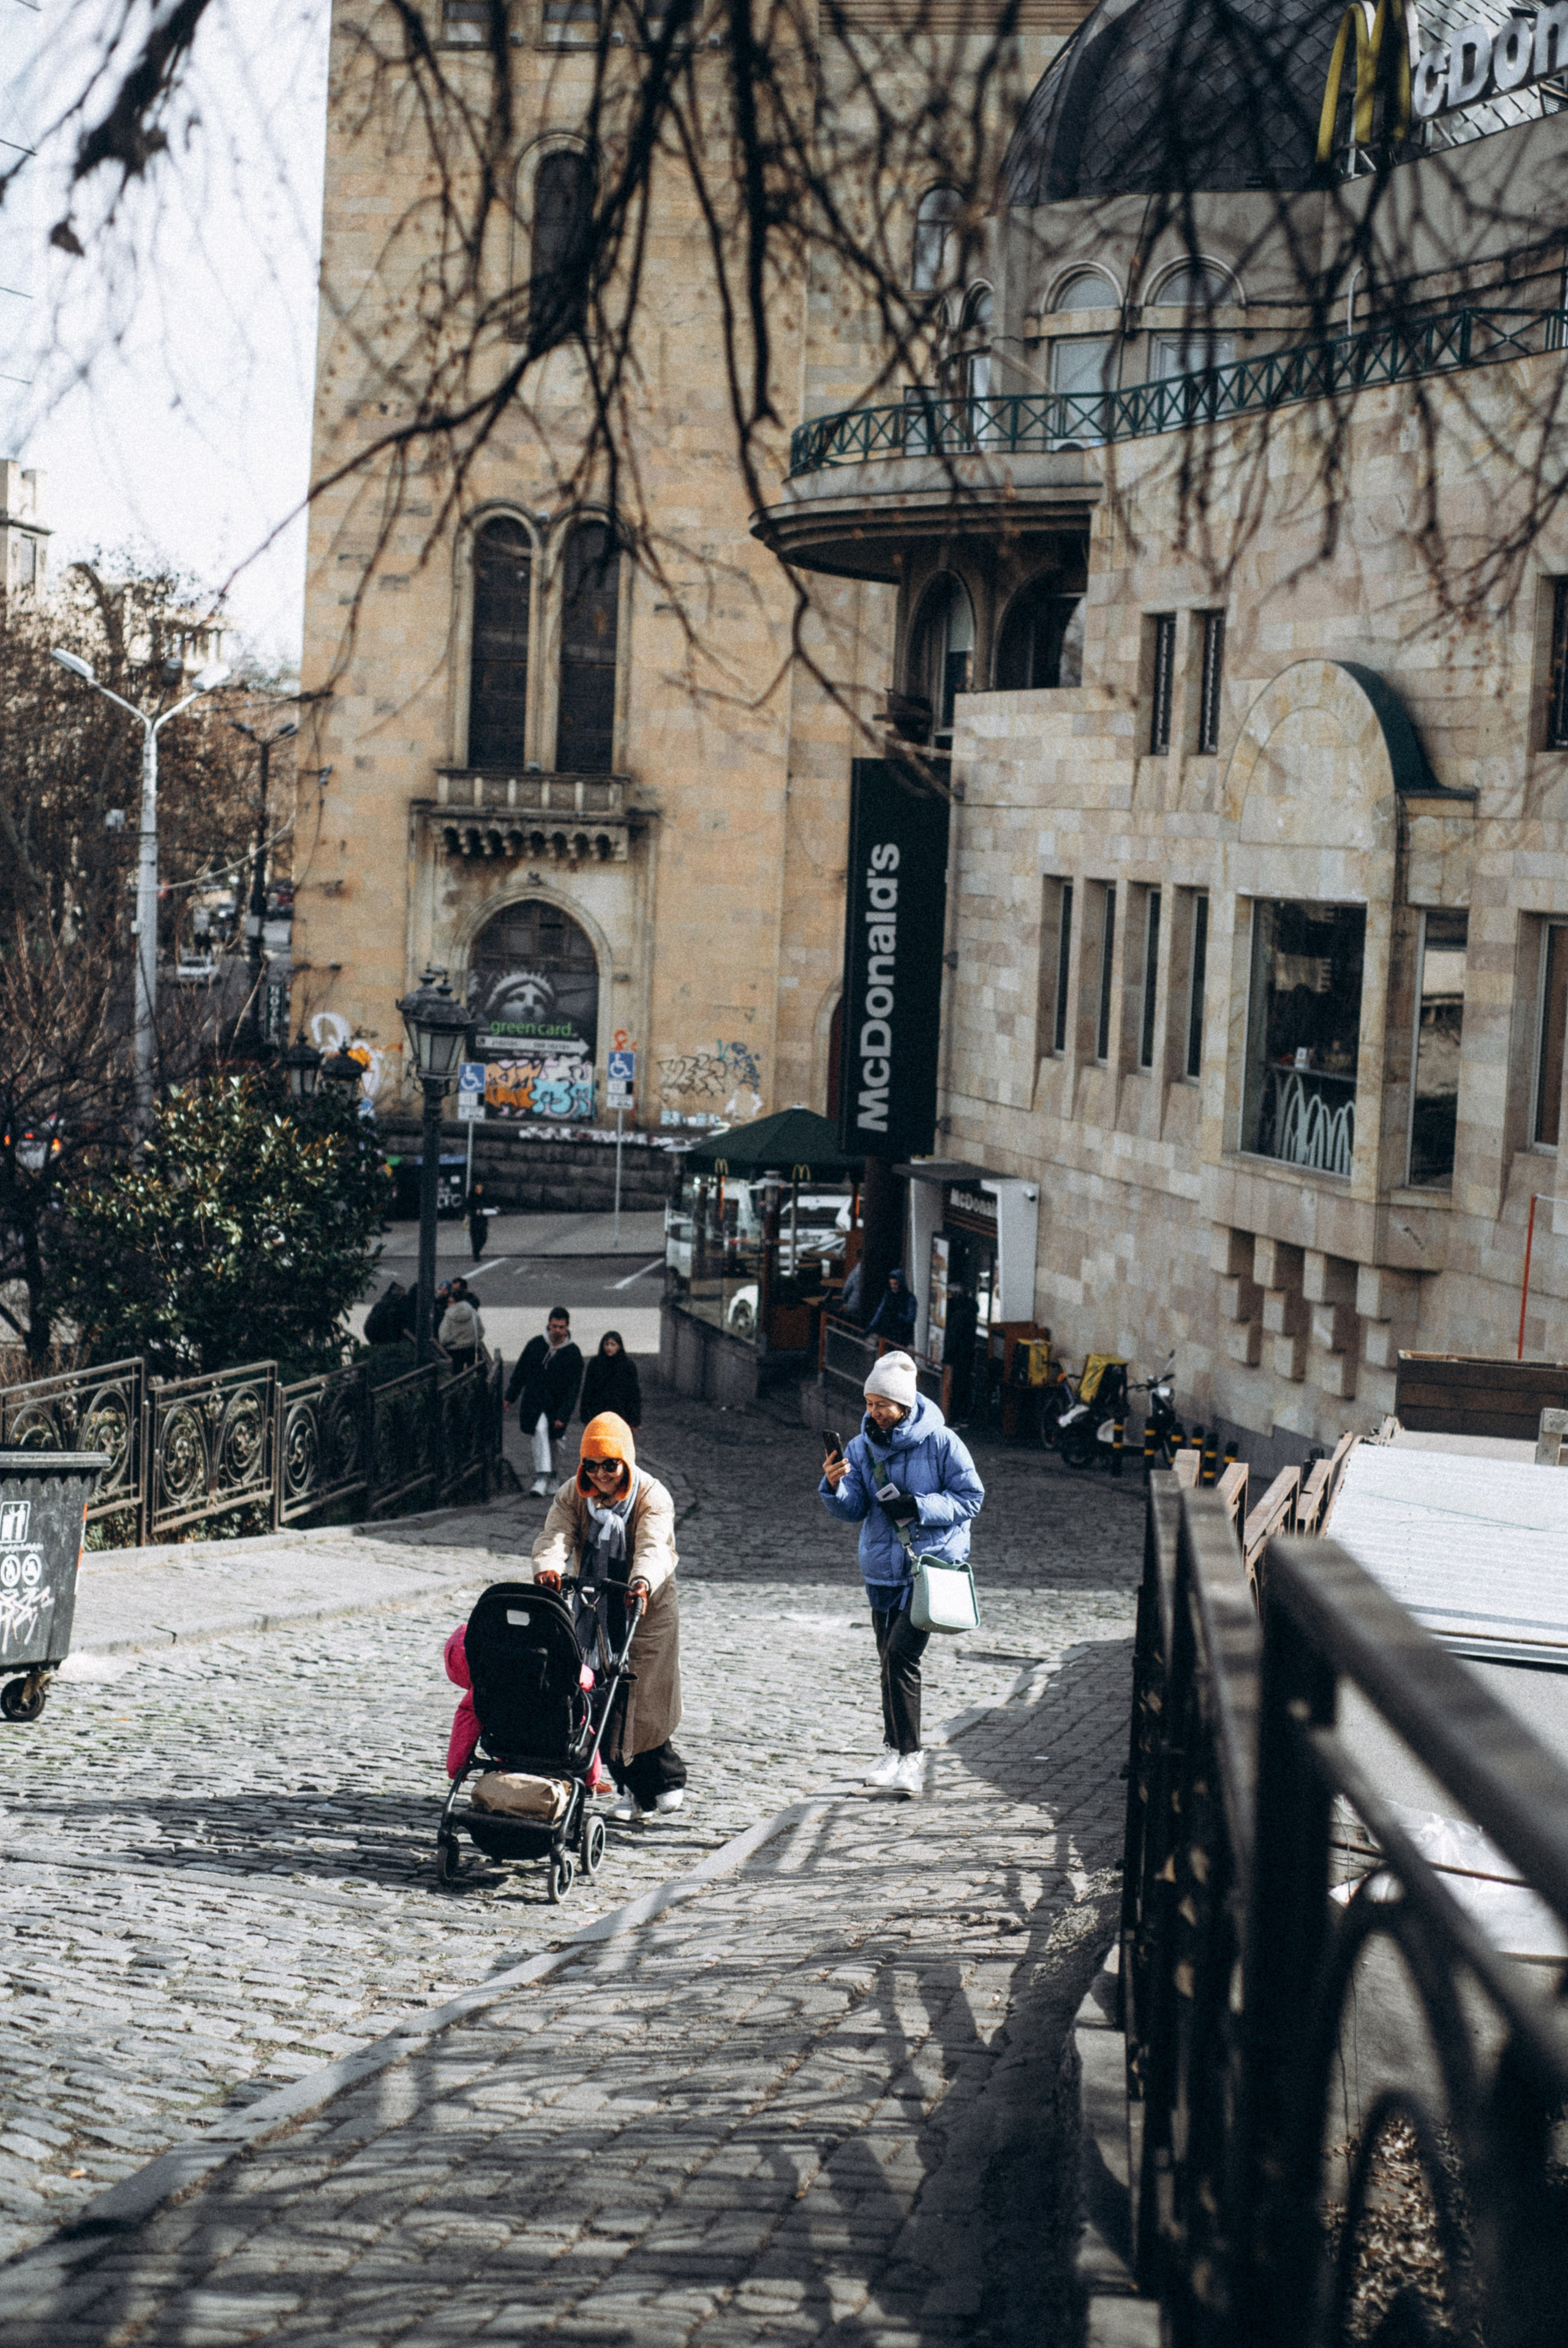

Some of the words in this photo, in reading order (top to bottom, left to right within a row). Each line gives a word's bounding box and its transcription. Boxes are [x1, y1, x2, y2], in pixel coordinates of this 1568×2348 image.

[491, 1021, 536, 1036] green
[537, 1021, 572, 1036] card
[858, 843, 900, 1133] McDonald's
